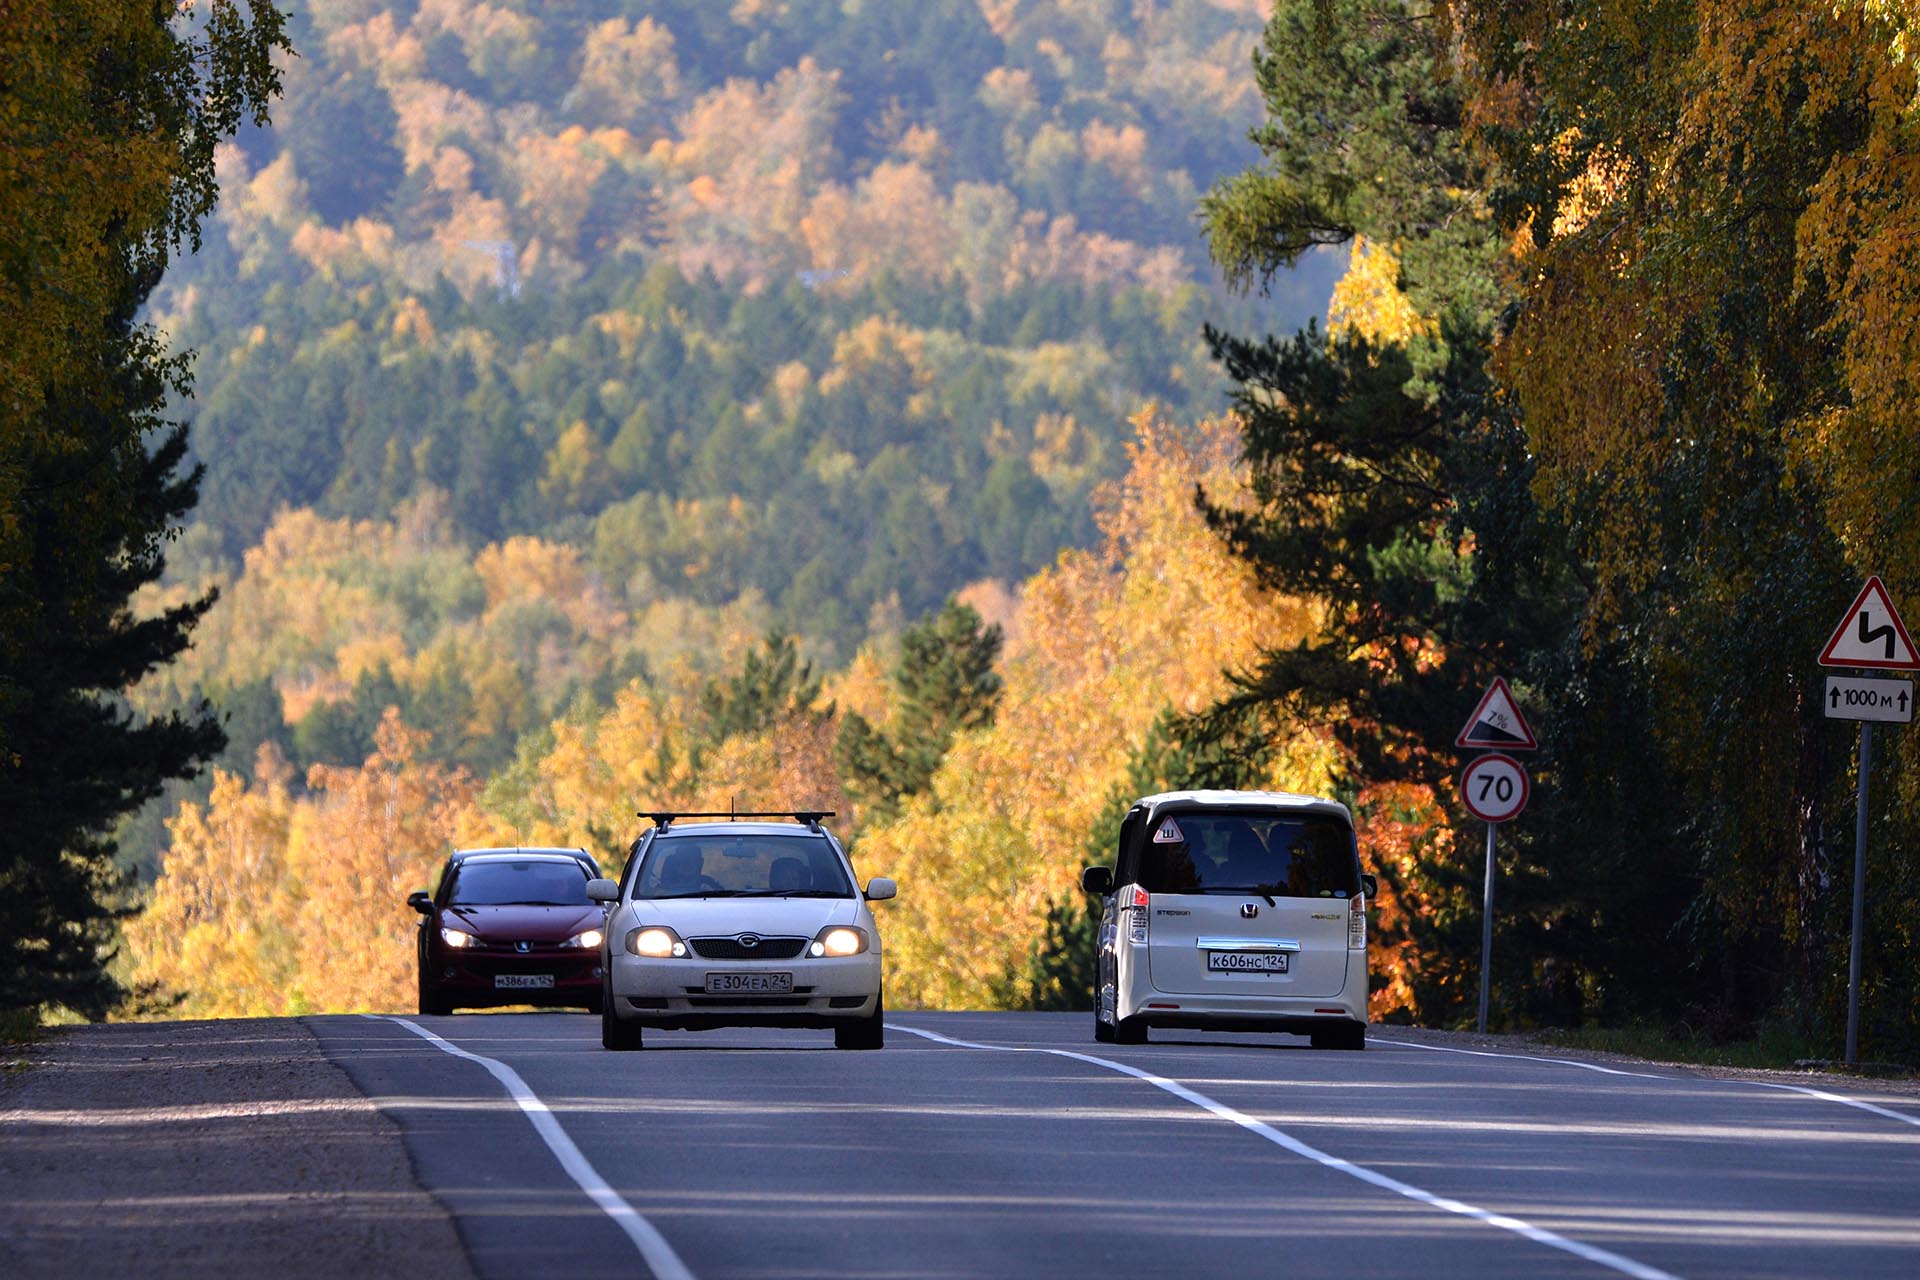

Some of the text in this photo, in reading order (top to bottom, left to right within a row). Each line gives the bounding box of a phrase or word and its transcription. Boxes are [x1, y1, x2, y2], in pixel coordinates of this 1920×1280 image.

[1844, 689, 1878, 706] 1000
[1487, 711, 1508, 729] 7%
[1477, 774, 1514, 802] 70
[1264, 955, 1284, 966] 124
[772, 975, 787, 986] 24
